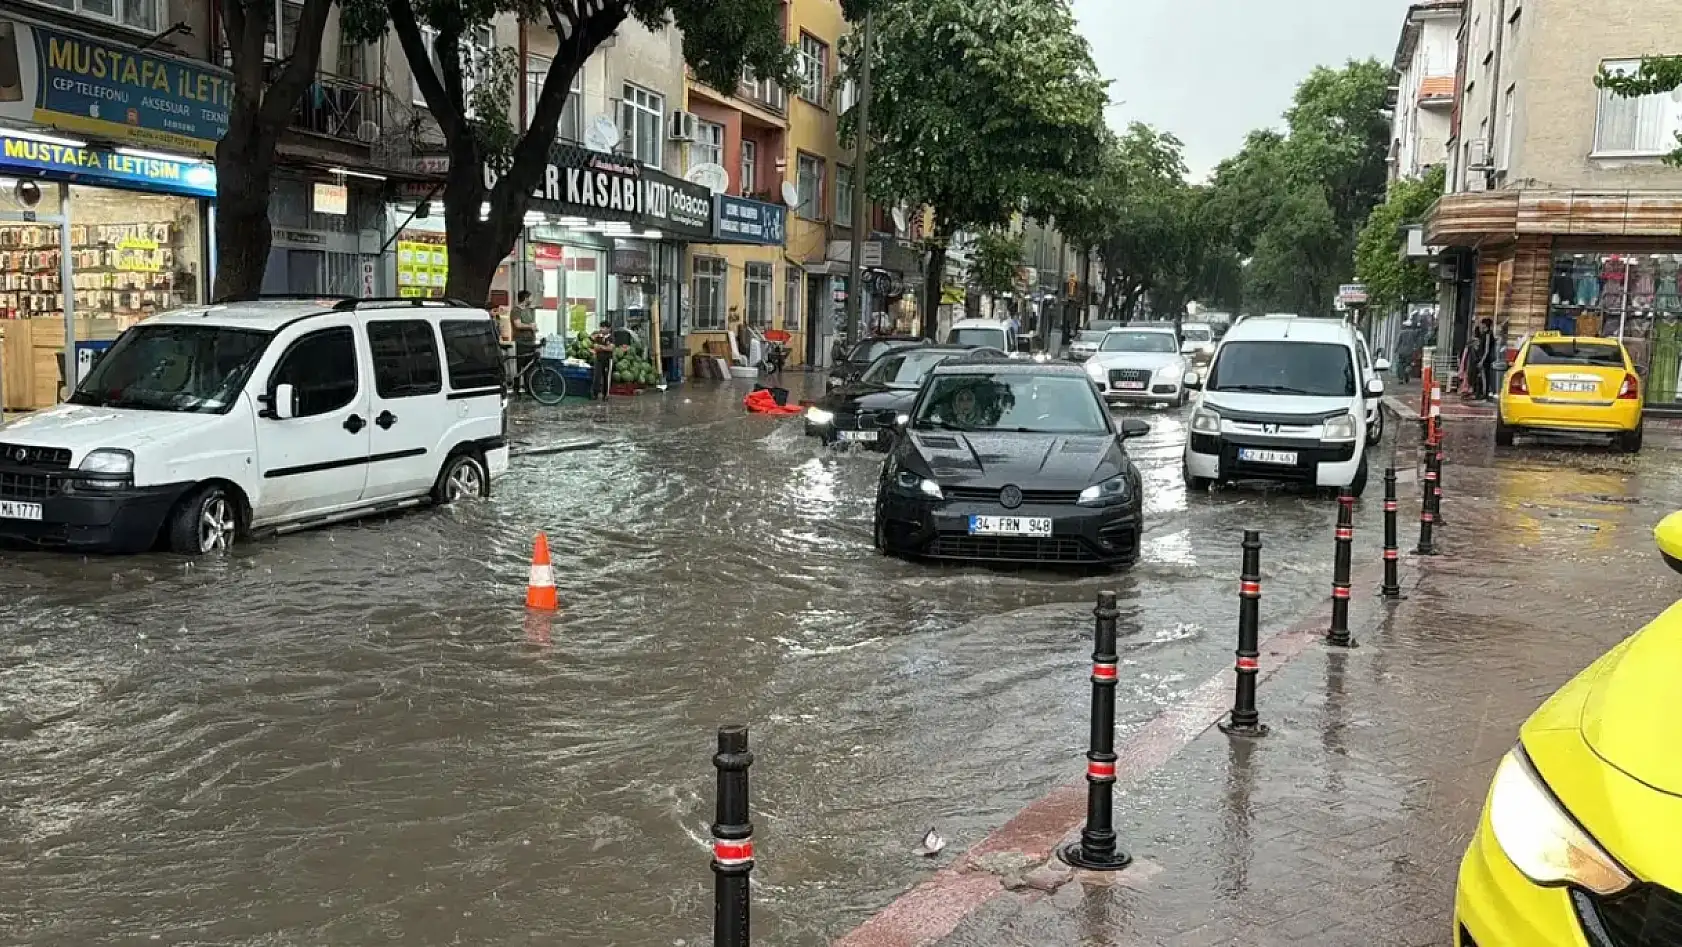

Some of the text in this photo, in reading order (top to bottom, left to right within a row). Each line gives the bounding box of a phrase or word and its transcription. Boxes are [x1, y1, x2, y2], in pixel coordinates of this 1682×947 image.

[49, 37, 171, 94] MUSTAFA
[53, 77, 74, 91] CEP
[76, 81, 129, 103] TELEFONU
[141, 96, 190, 117] AKSESUAR
[3, 138, 101, 169] MUSTAFA
[565, 167, 642, 214] KASABI
[667, 185, 710, 218] Tobacco
[17, 503, 41, 517] 1777
[976, 517, 1051, 532] 34 FRN 948
